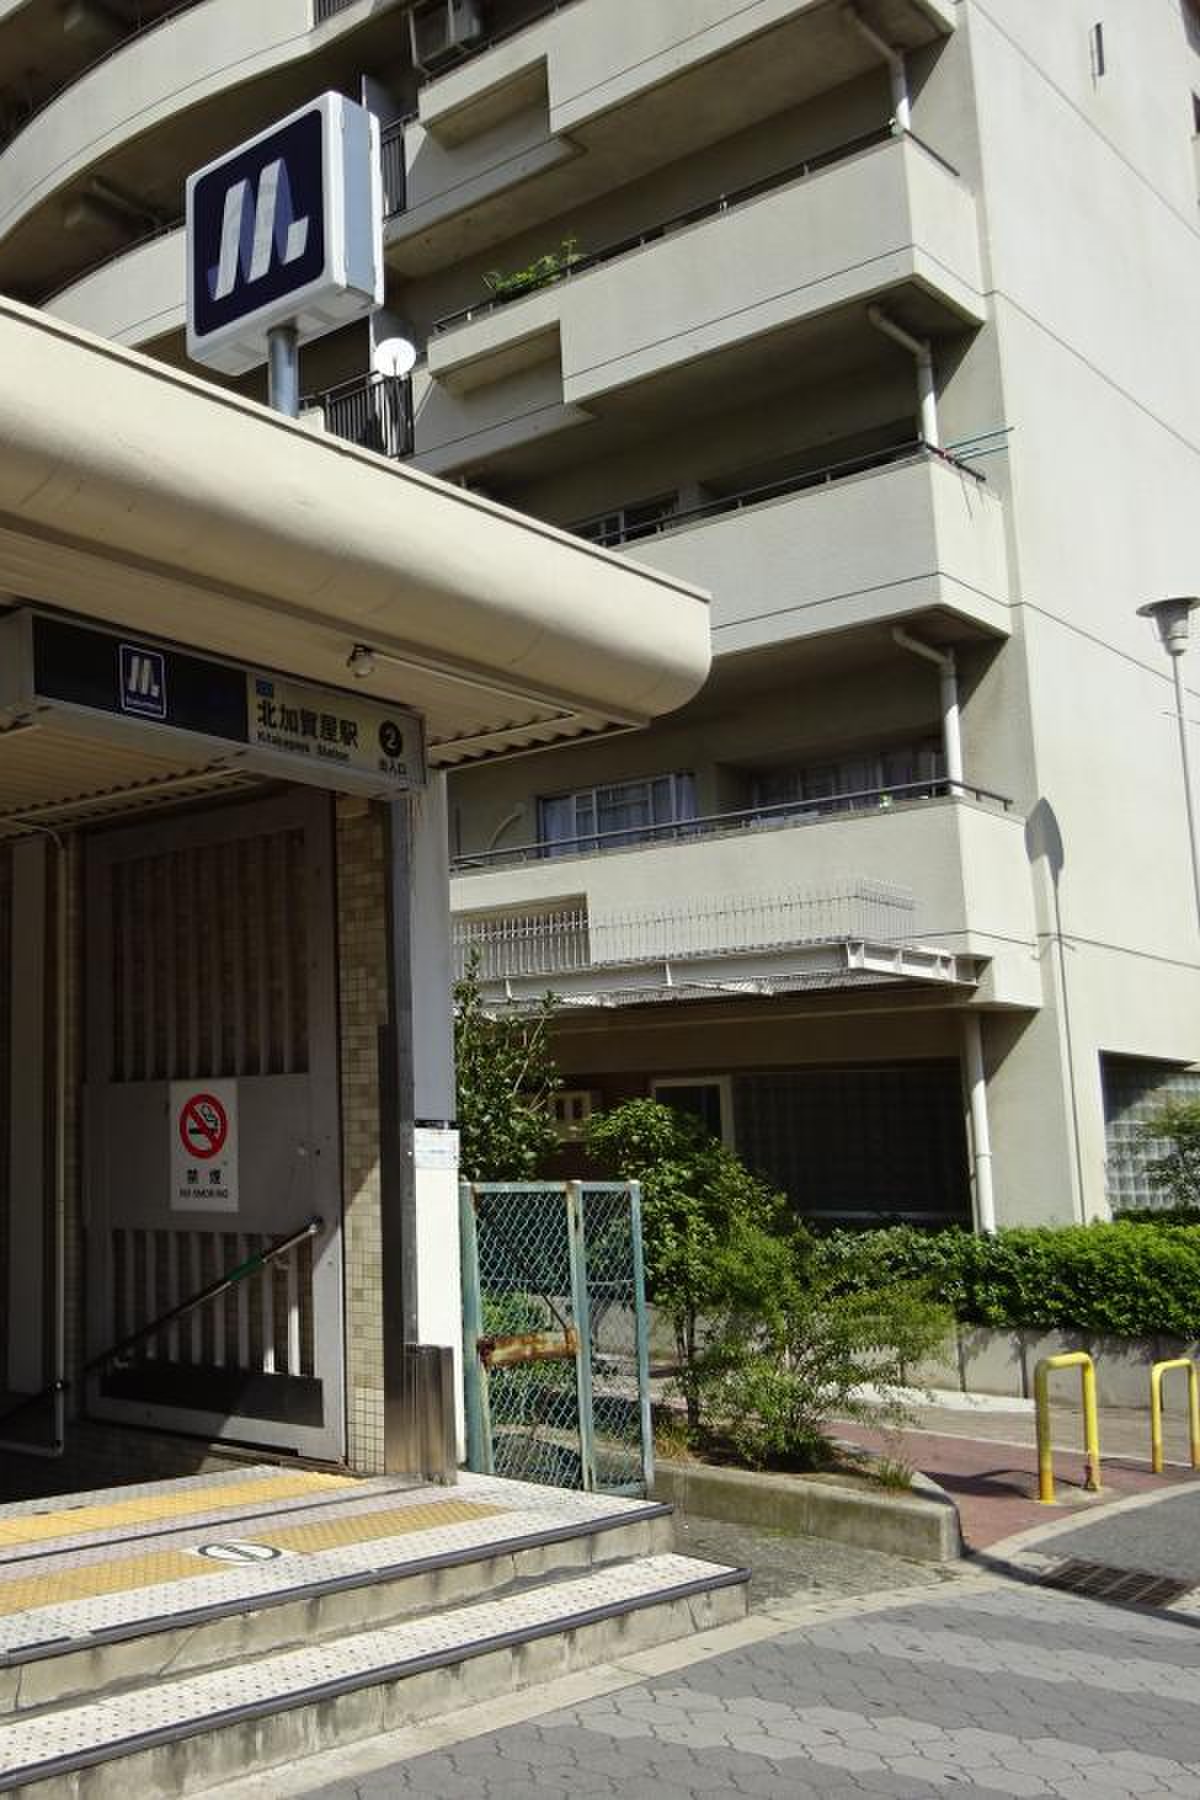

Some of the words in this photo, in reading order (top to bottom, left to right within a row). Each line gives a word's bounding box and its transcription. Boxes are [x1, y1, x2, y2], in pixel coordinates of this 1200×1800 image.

[257, 699, 358, 749] 北加賀屋駅
